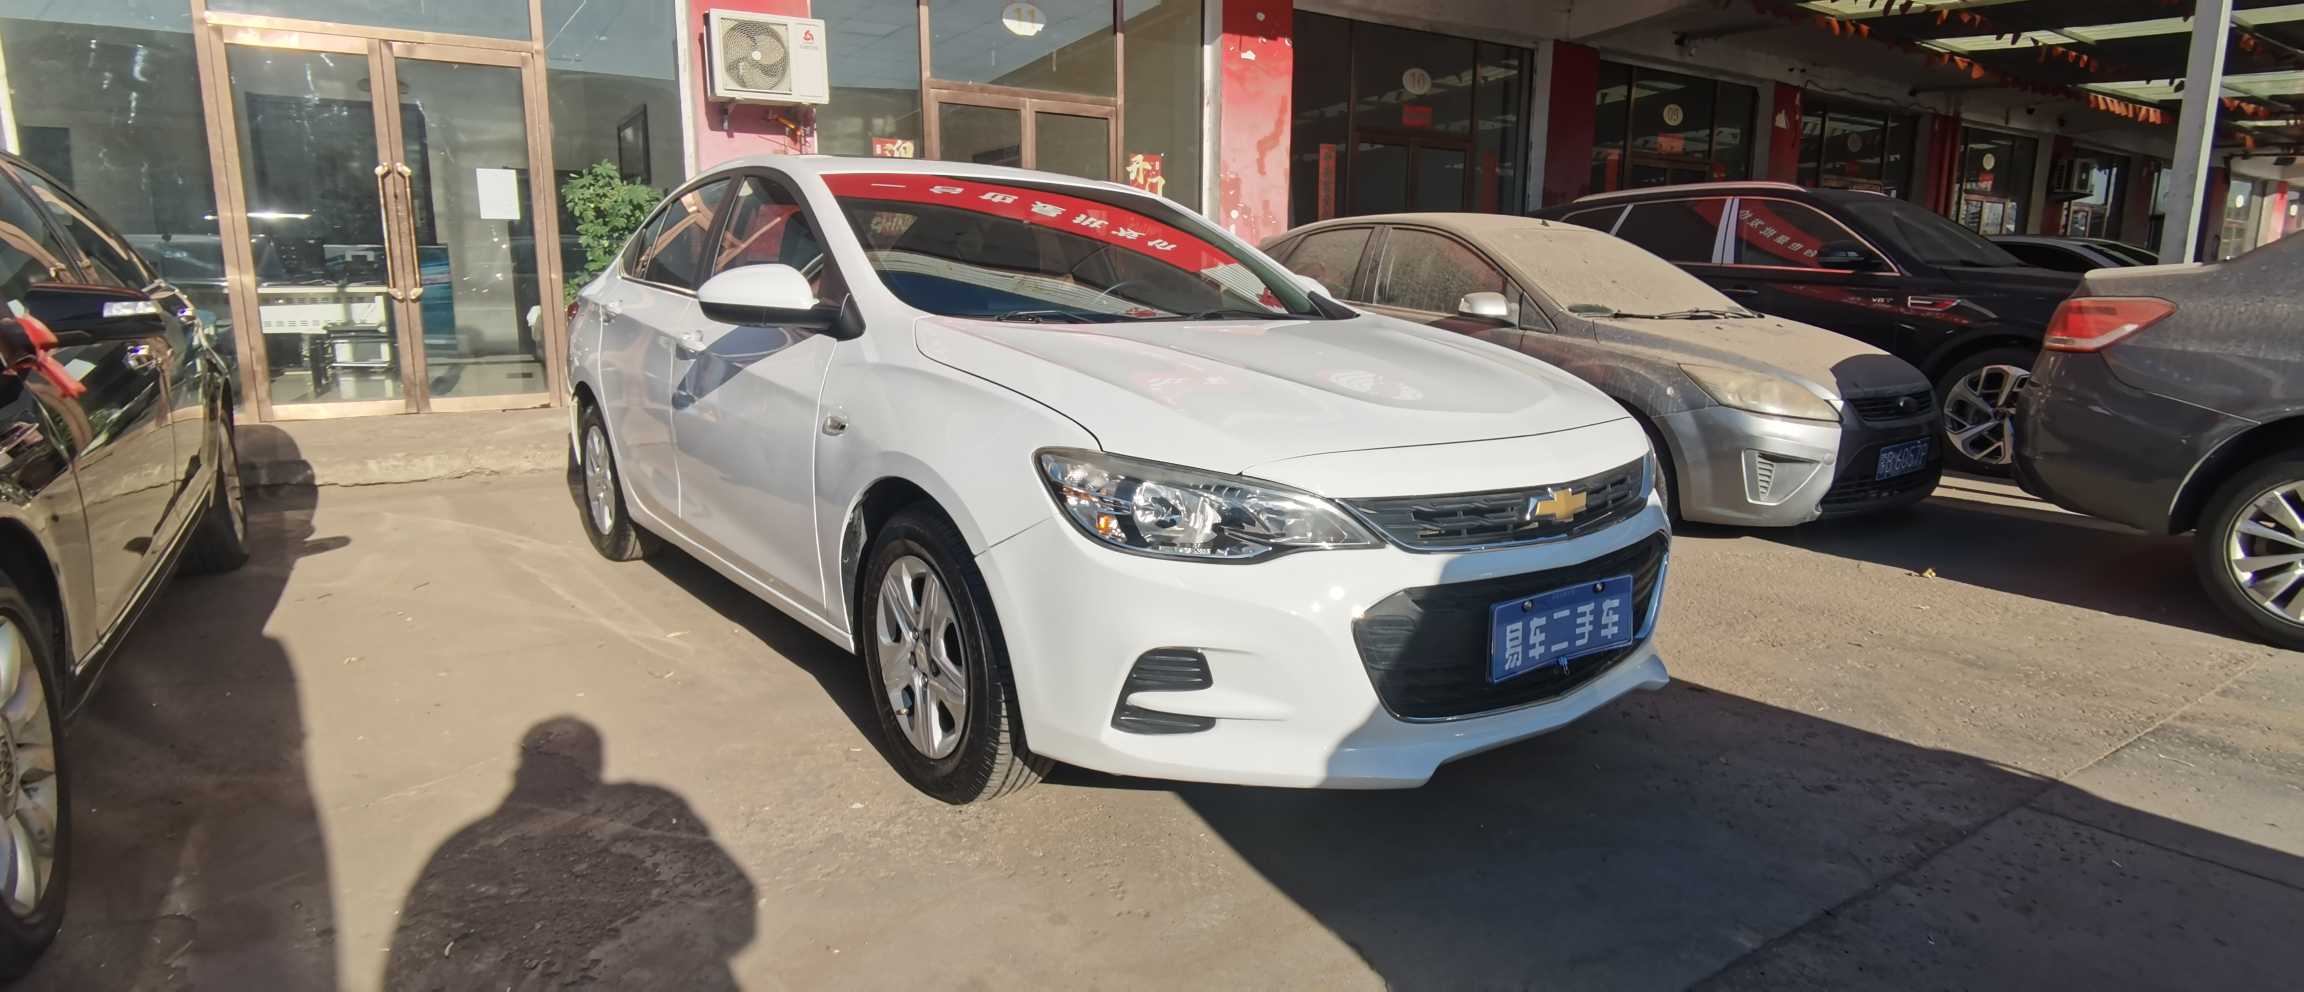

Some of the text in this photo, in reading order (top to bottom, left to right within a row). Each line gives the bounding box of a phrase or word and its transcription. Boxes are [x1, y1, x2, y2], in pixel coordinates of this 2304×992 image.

[1504, 599, 1620, 670] 易车二手车
